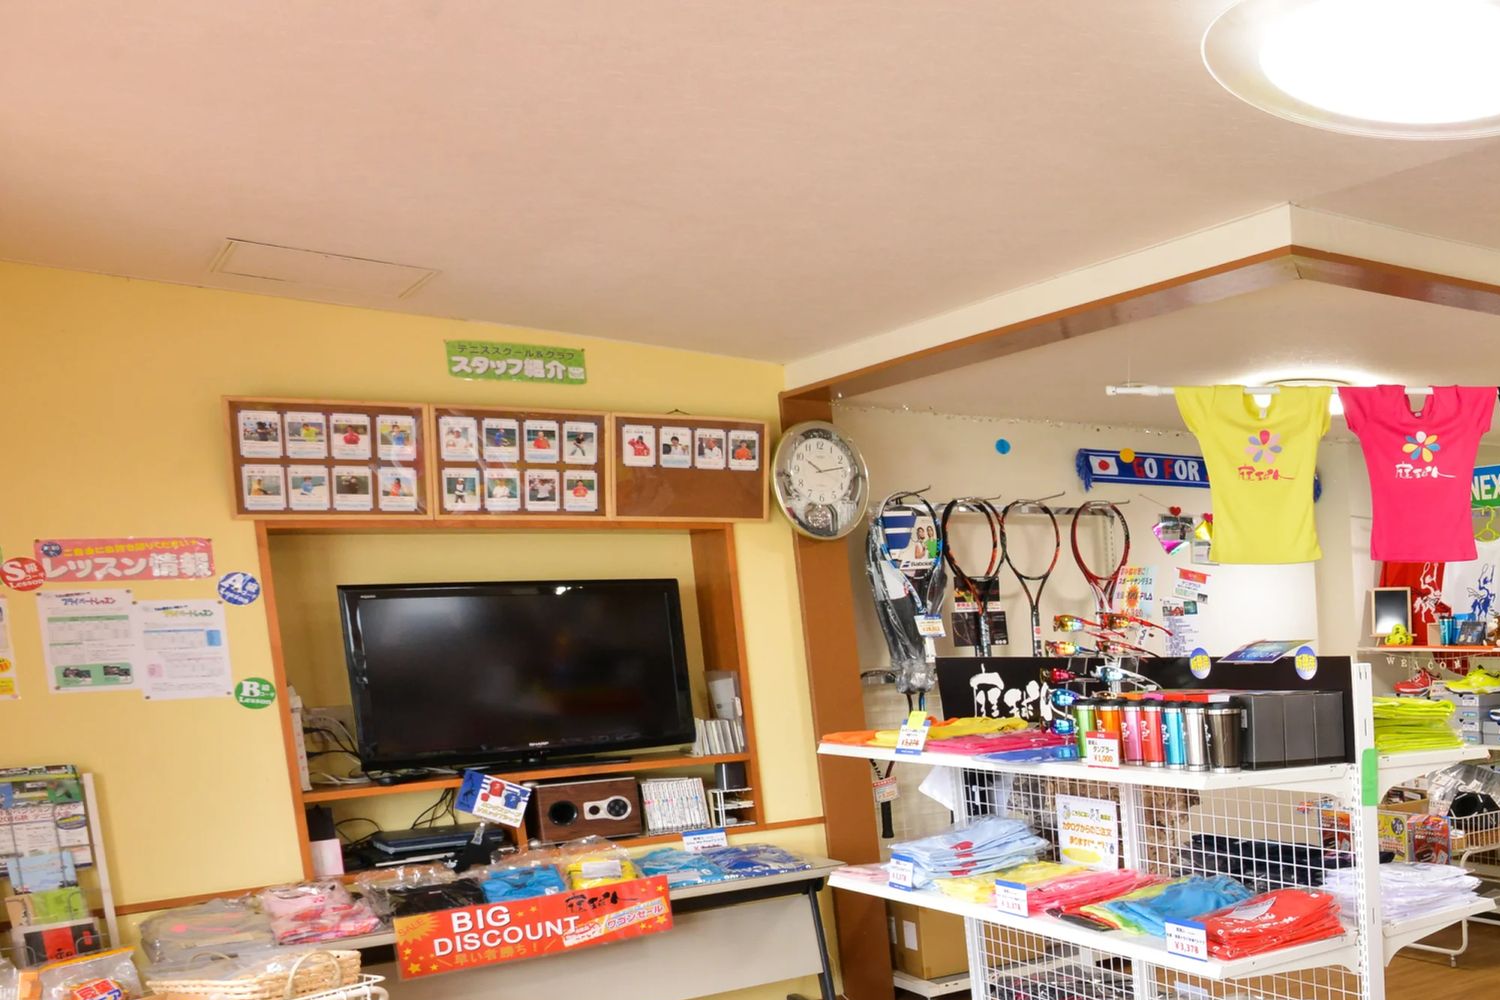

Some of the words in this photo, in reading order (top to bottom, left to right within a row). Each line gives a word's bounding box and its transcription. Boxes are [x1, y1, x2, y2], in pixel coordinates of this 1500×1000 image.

[450, 355, 566, 380] スタッフ紹介
[1132, 457, 1158, 479] GO
[1163, 458, 1201, 481] FOR
[43, 551, 212, 580] レッスン情報
[8, 577, 45, 589] Lesson
[398, 918, 426, 938] SALE
[451, 905, 512, 933] BIG
[433, 915, 580, 957] DISCOUNT
